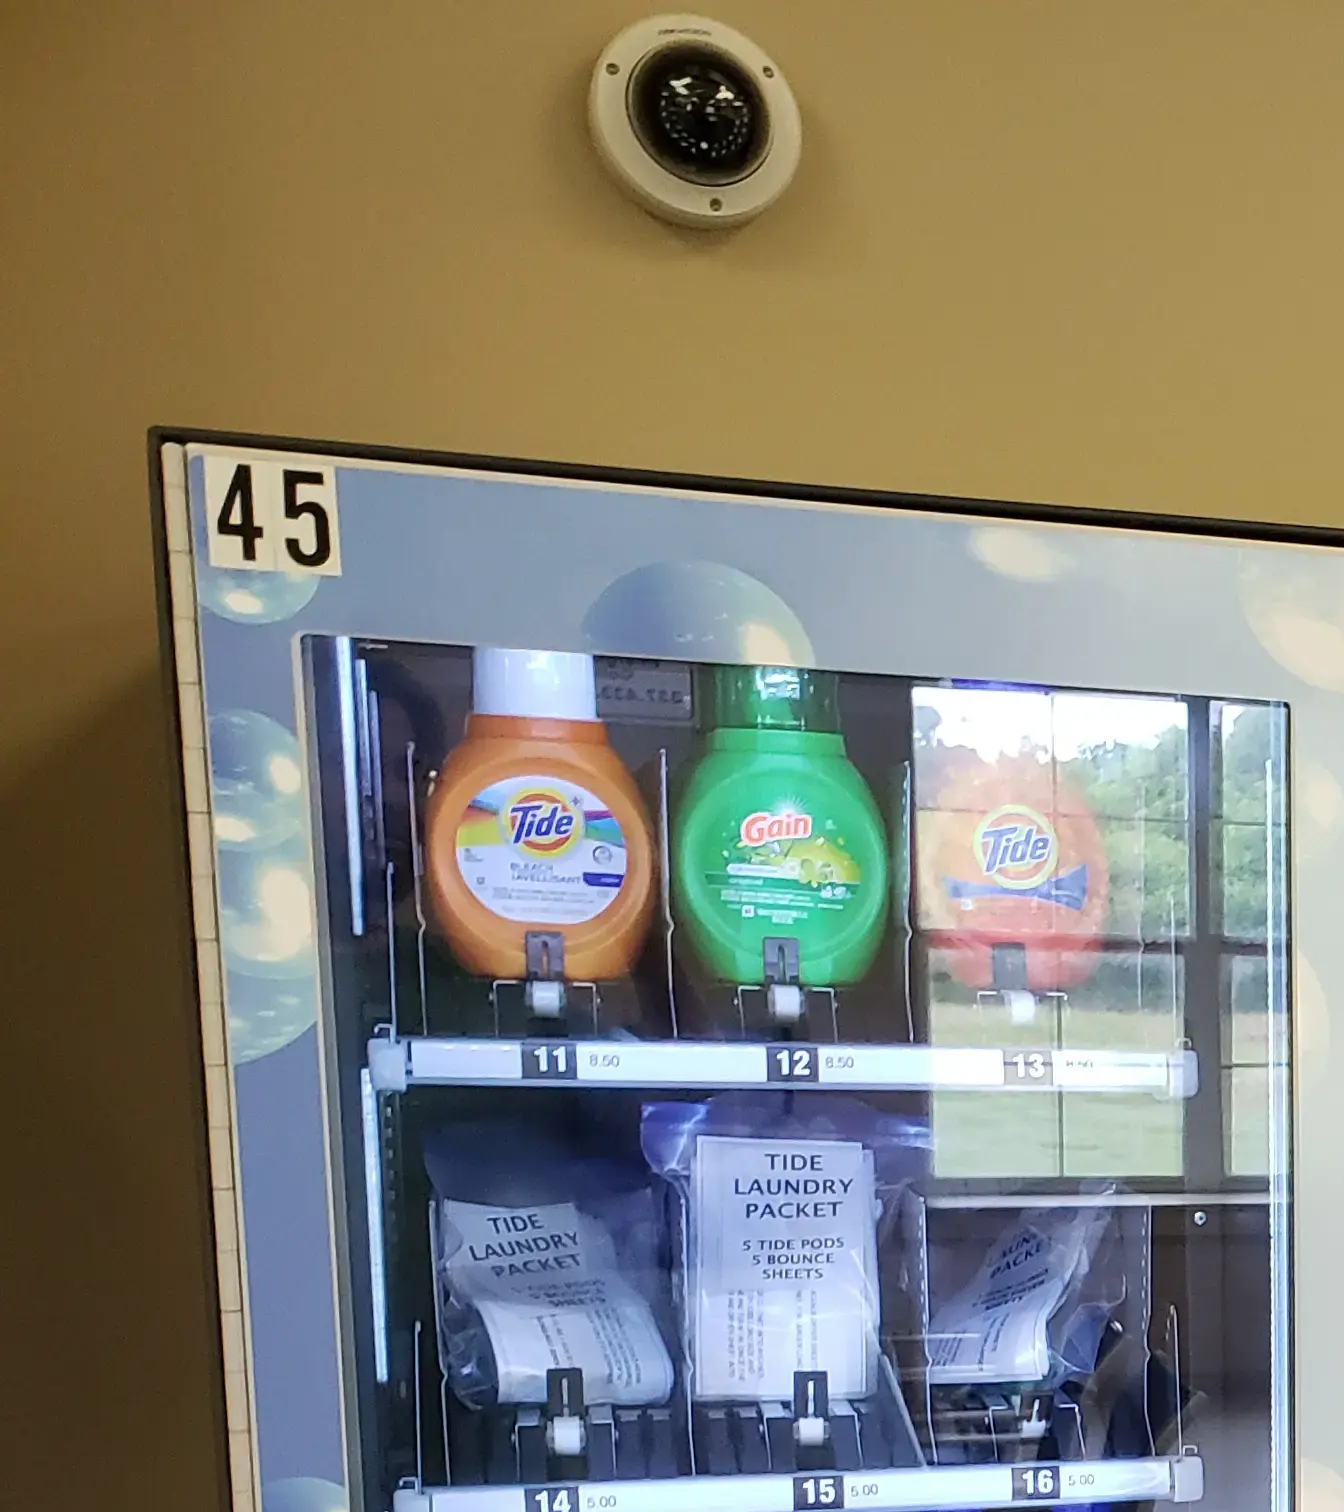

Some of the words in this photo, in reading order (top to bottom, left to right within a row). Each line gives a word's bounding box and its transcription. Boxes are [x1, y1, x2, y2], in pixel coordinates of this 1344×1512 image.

[217, 464, 330, 567] 45
[510, 804, 573, 844] Tide
[742, 812, 811, 845] Gain
[981, 827, 1050, 873] Tide
[533, 1048, 569, 1076] 11
[589, 1055, 620, 1069] 8.50
[776, 1050, 811, 1077] 12
[825, 1056, 854, 1070] 8.50
[1012, 1053, 1045, 1078] 13
[765, 1153, 823, 1171] TIDE
[734, 1178, 853, 1195] LAUNDRY
[745, 1201, 843, 1219] PACKET
[487, 1214, 544, 1234] TIDE
[469, 1232, 579, 1261] LAUNDRY
[743, 1240, 751, 1251] 5
[758, 1239, 795, 1251] TIDE
[801, 1237, 844, 1250] PODS
[491, 1253, 580, 1277] PACKET
[767, 1253, 834, 1265] BOUNCE
[762, 1268, 823, 1279] SHEETS
[802, 1478, 835, 1505] 15
[851, 1483, 879, 1497] 5.00
[1021, 1469, 1054, 1495] 16
[587, 1495, 617, 1509] 5.00
